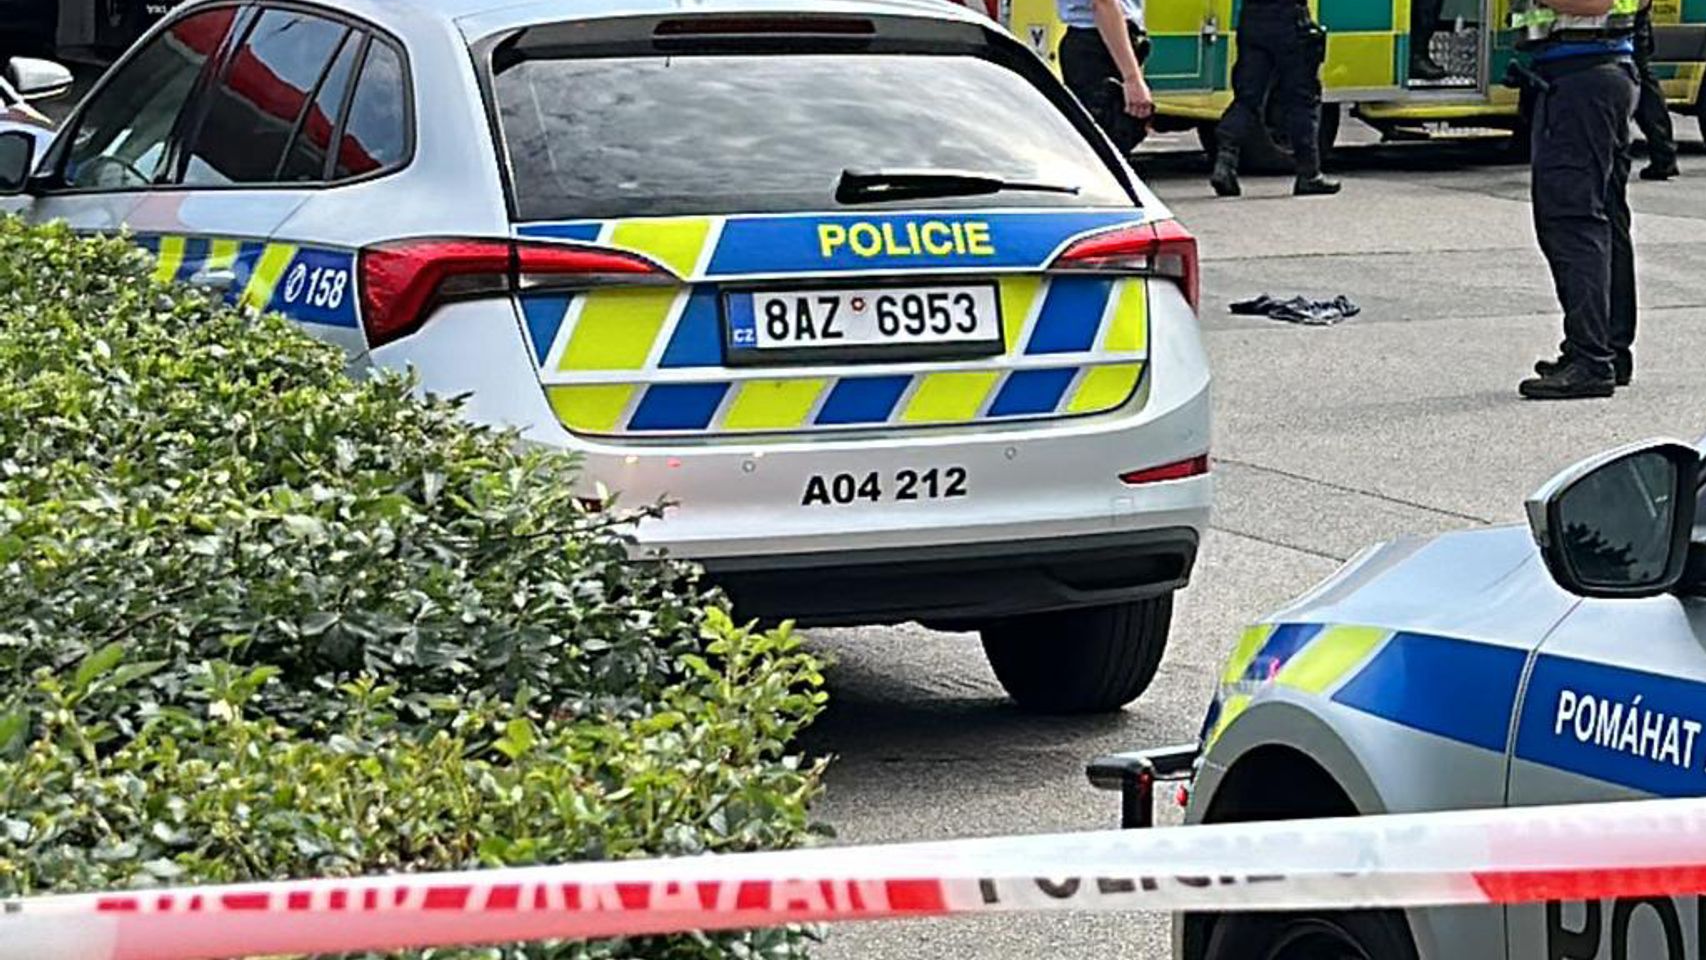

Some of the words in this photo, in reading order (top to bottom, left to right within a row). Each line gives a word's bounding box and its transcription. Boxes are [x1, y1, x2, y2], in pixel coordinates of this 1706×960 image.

[818, 220, 995, 257] POLICIE
[306, 266, 348, 309] 158
[734, 329, 755, 343] CZ
[765, 296, 843, 341] 8AZ
[876, 292, 978, 336] 6953
[802, 471, 881, 505] A04
[895, 466, 968, 500] 212
[1555, 689, 1702, 770] POMÁHAT
